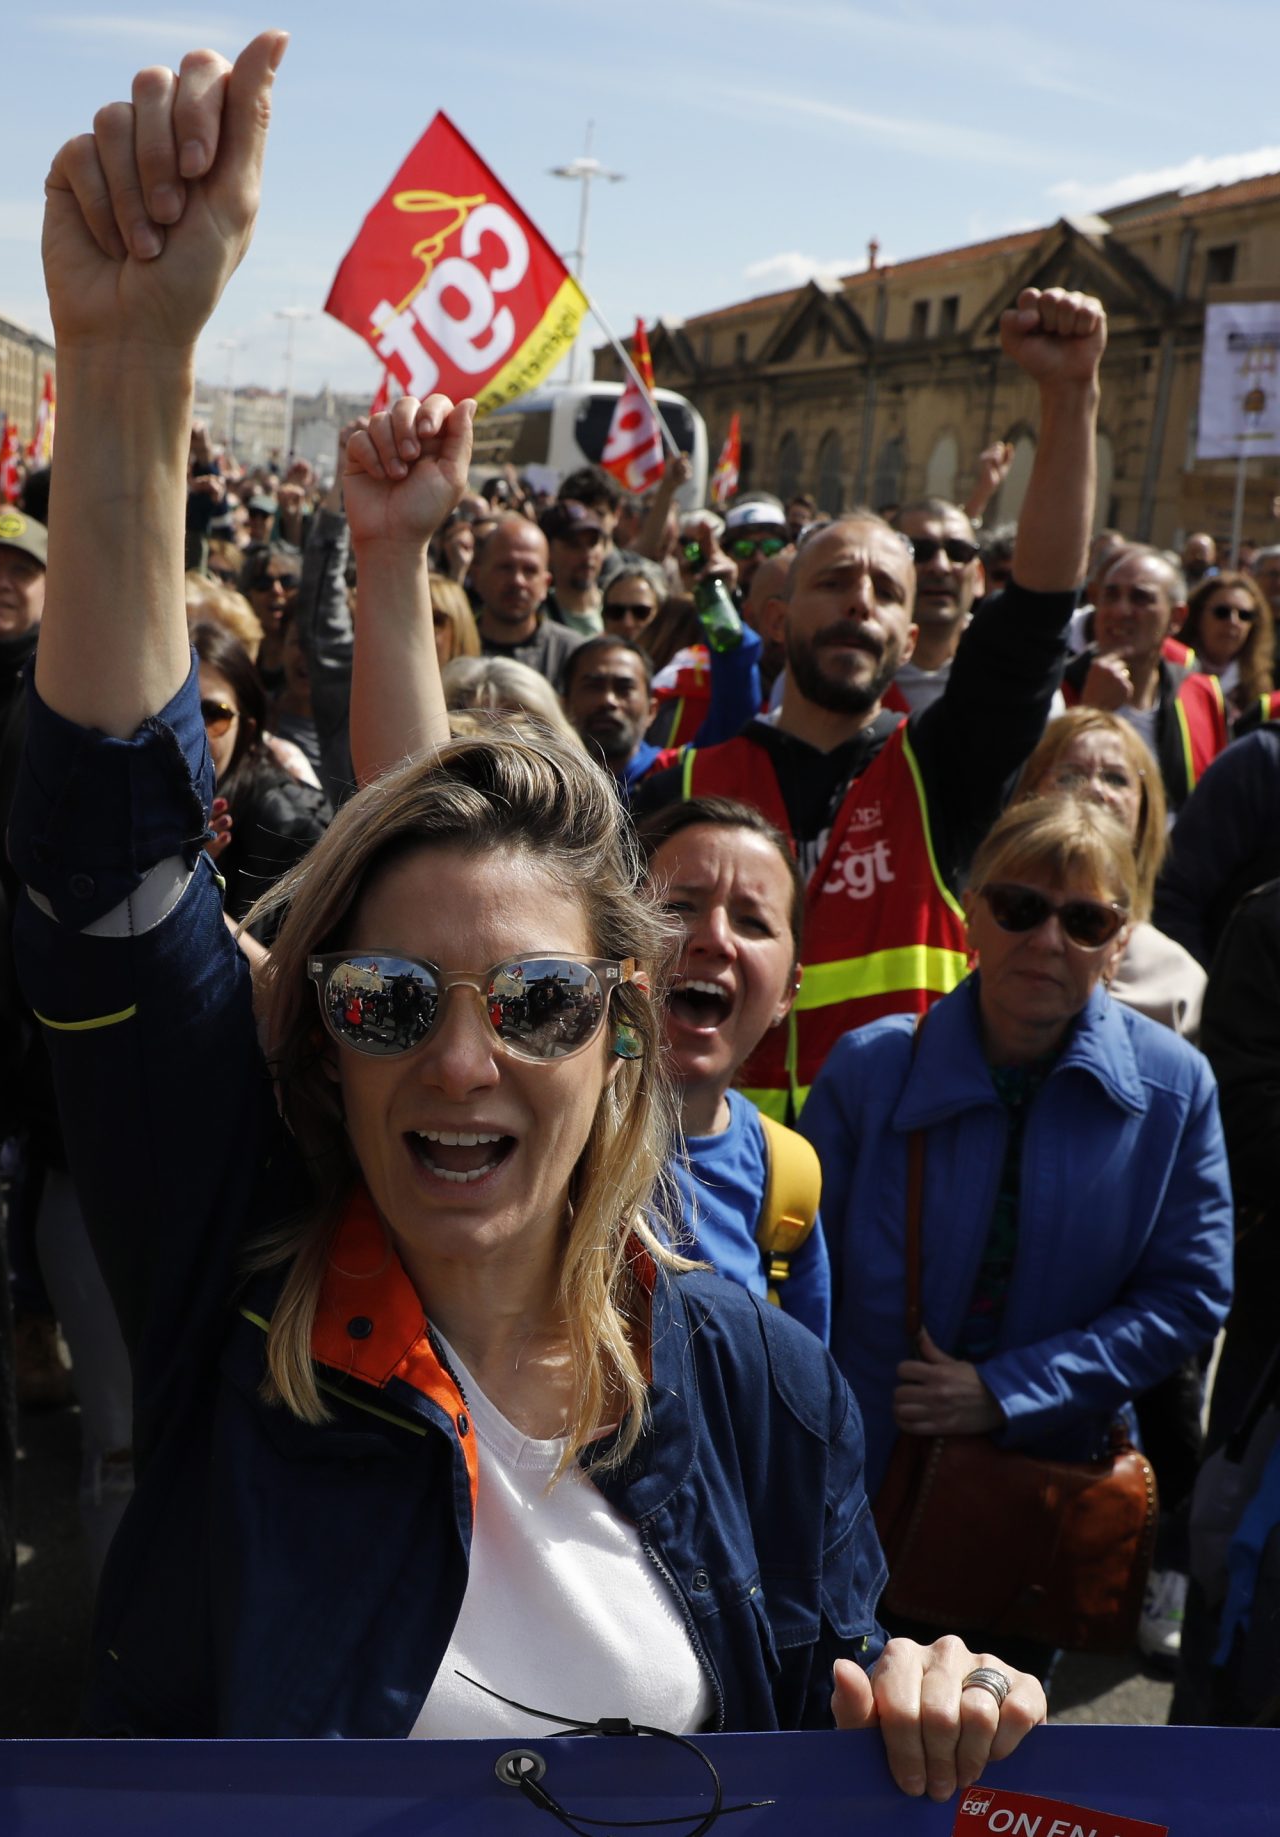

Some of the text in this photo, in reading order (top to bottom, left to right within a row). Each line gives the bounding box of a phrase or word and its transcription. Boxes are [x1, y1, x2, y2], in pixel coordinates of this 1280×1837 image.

[822, 841, 895, 899] cgt
[961, 1799, 990, 1816] cgt
[987, 1809, 1043, 1837] ON
